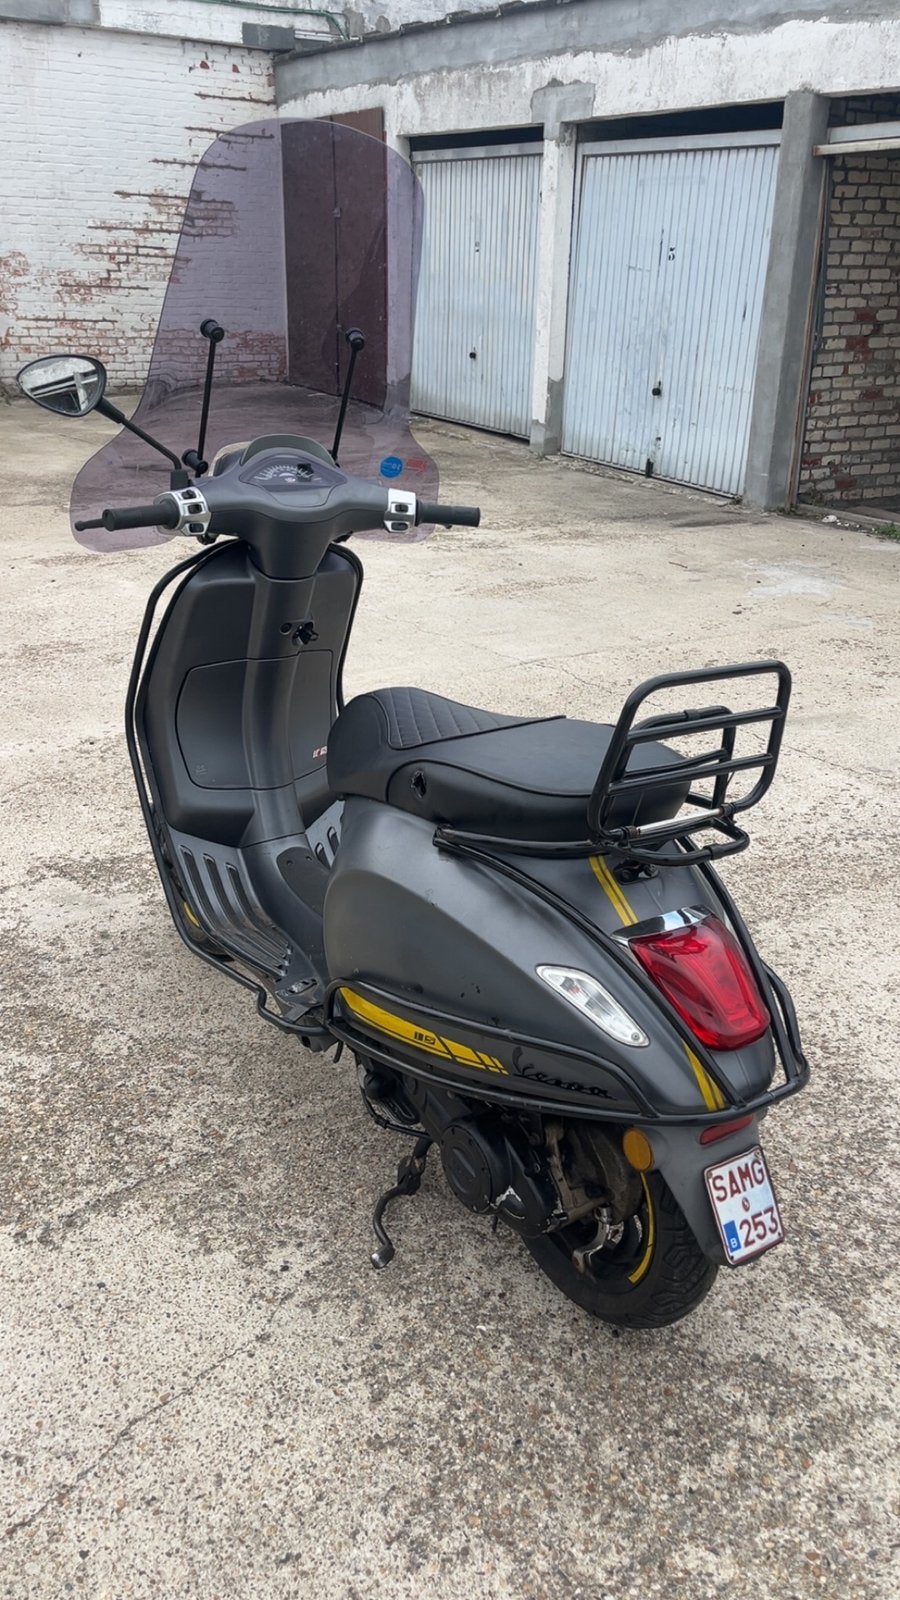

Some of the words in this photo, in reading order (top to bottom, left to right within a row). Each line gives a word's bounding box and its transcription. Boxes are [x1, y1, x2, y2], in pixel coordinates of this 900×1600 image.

[712, 1160, 765, 1202] SAMG
[730, 1237, 738, 1249] B
[739, 1205, 779, 1248] 253
